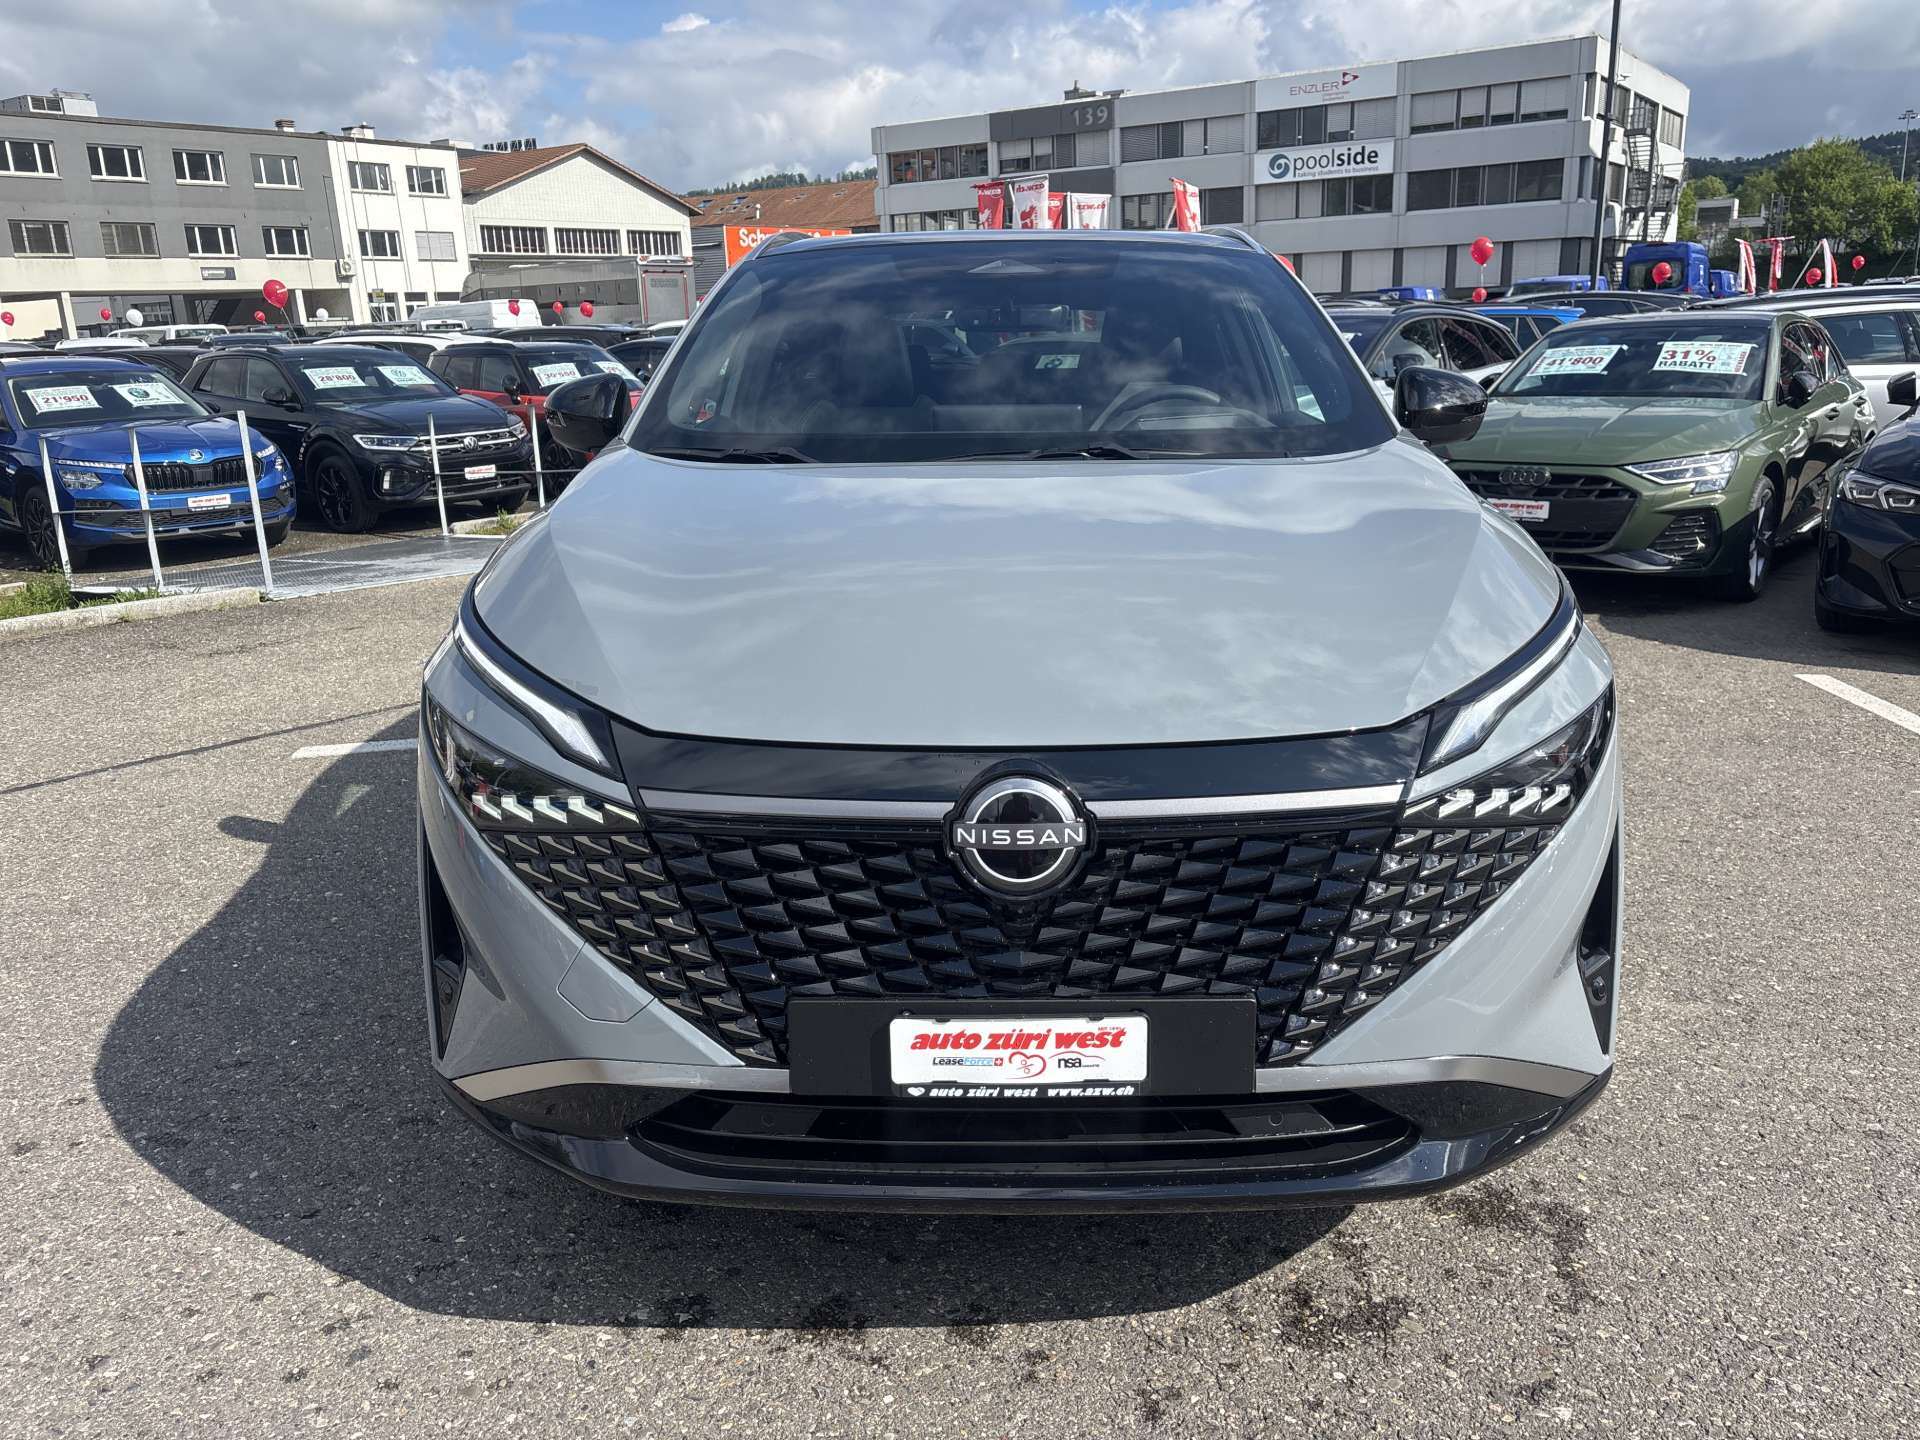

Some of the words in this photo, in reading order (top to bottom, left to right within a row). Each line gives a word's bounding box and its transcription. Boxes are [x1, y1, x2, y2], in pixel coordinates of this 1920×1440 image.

[1289, 81, 1340, 96] ENZLER
[1073, 106, 1108, 127] 139
[1293, 145, 1379, 178] poolside
[1662, 349, 1717, 362] 31%
[1658, 360, 1715, 369] RABATT
[41, 394, 89, 404] 21'950
[957, 826, 1083, 845] NISSAN
[910, 1029, 982, 1050] auto
[983, 1028, 1052, 1050] züri
[1055, 1027, 1127, 1049] west
[932, 1056, 993, 1066] LeaseForce
[1058, 1057, 1082, 1068] nsa
[929, 1087, 964, 1097] auto
[966, 1085, 1000, 1097] züri
[1003, 1087, 1038, 1097] west
[1047, 1085, 1135, 1097] www.azw.ch
